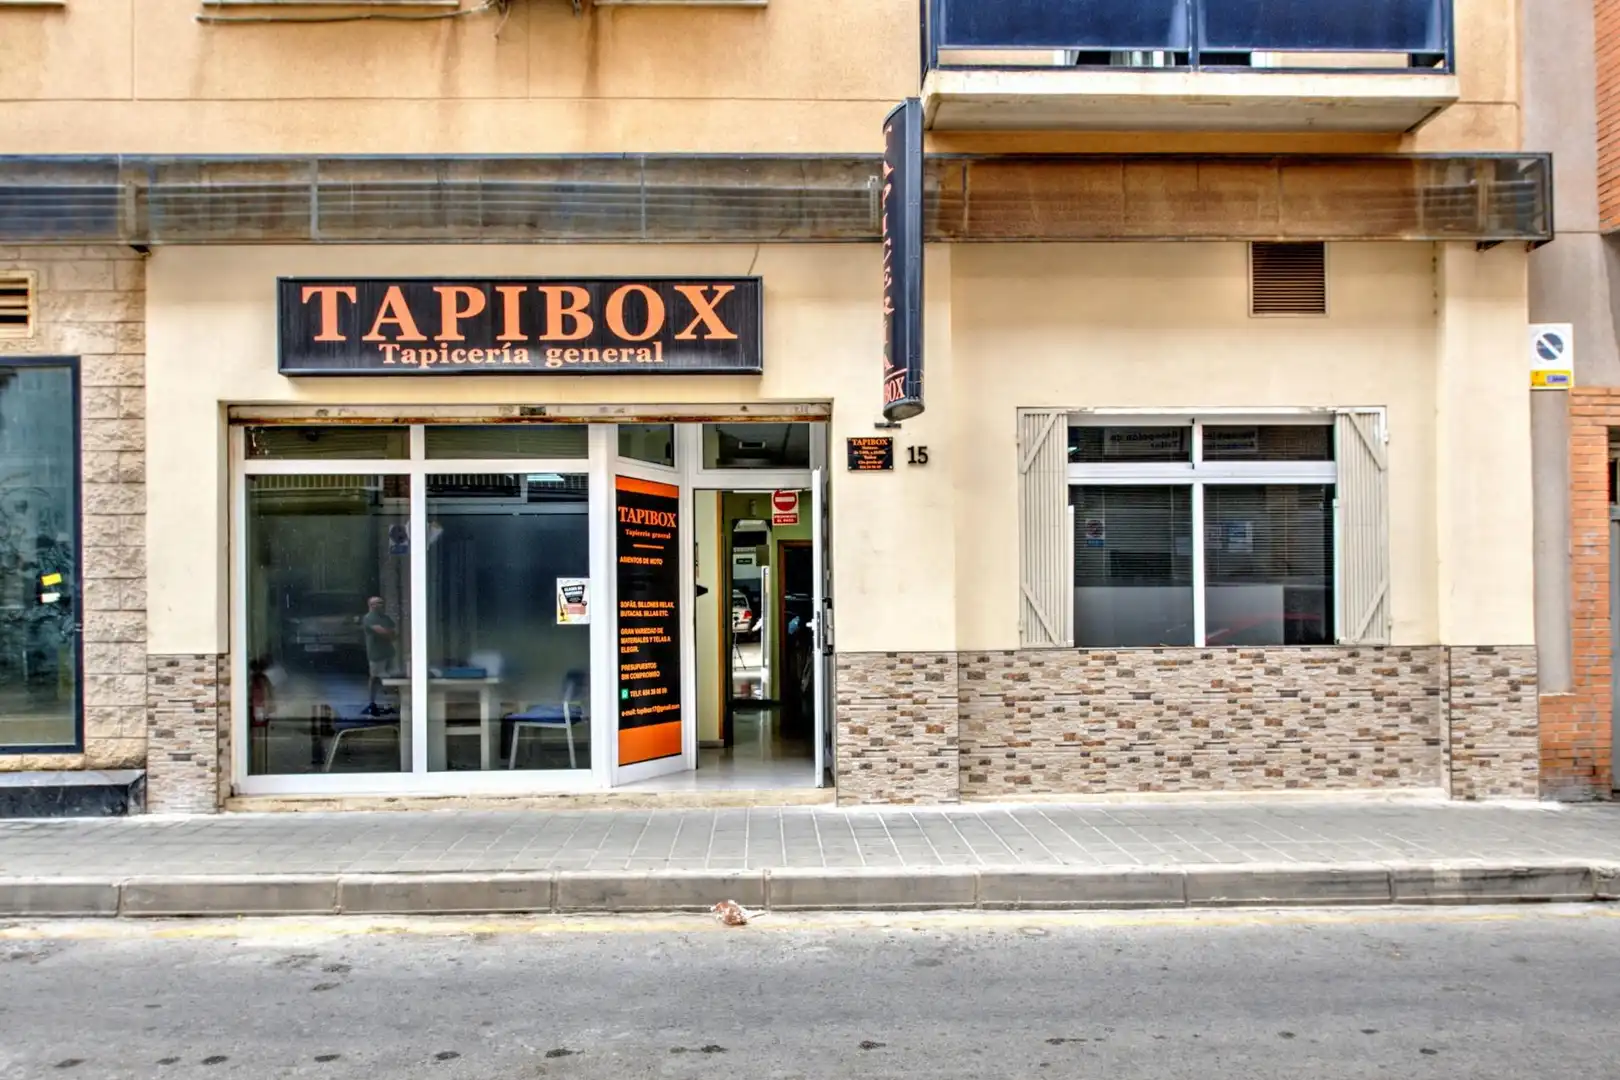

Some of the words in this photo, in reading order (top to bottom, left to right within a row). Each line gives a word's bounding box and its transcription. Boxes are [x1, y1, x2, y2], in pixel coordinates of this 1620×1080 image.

[302, 284, 738, 342] TAPIBOX
[379, 342, 530, 368] Tapicería
[545, 342, 663, 367] general
[851, 438, 888, 446] TAPIBOX
[907, 445, 929, 464] 15
[618, 507, 676, 527] TAPIBOX
[620, 627, 634, 635] GRAN
